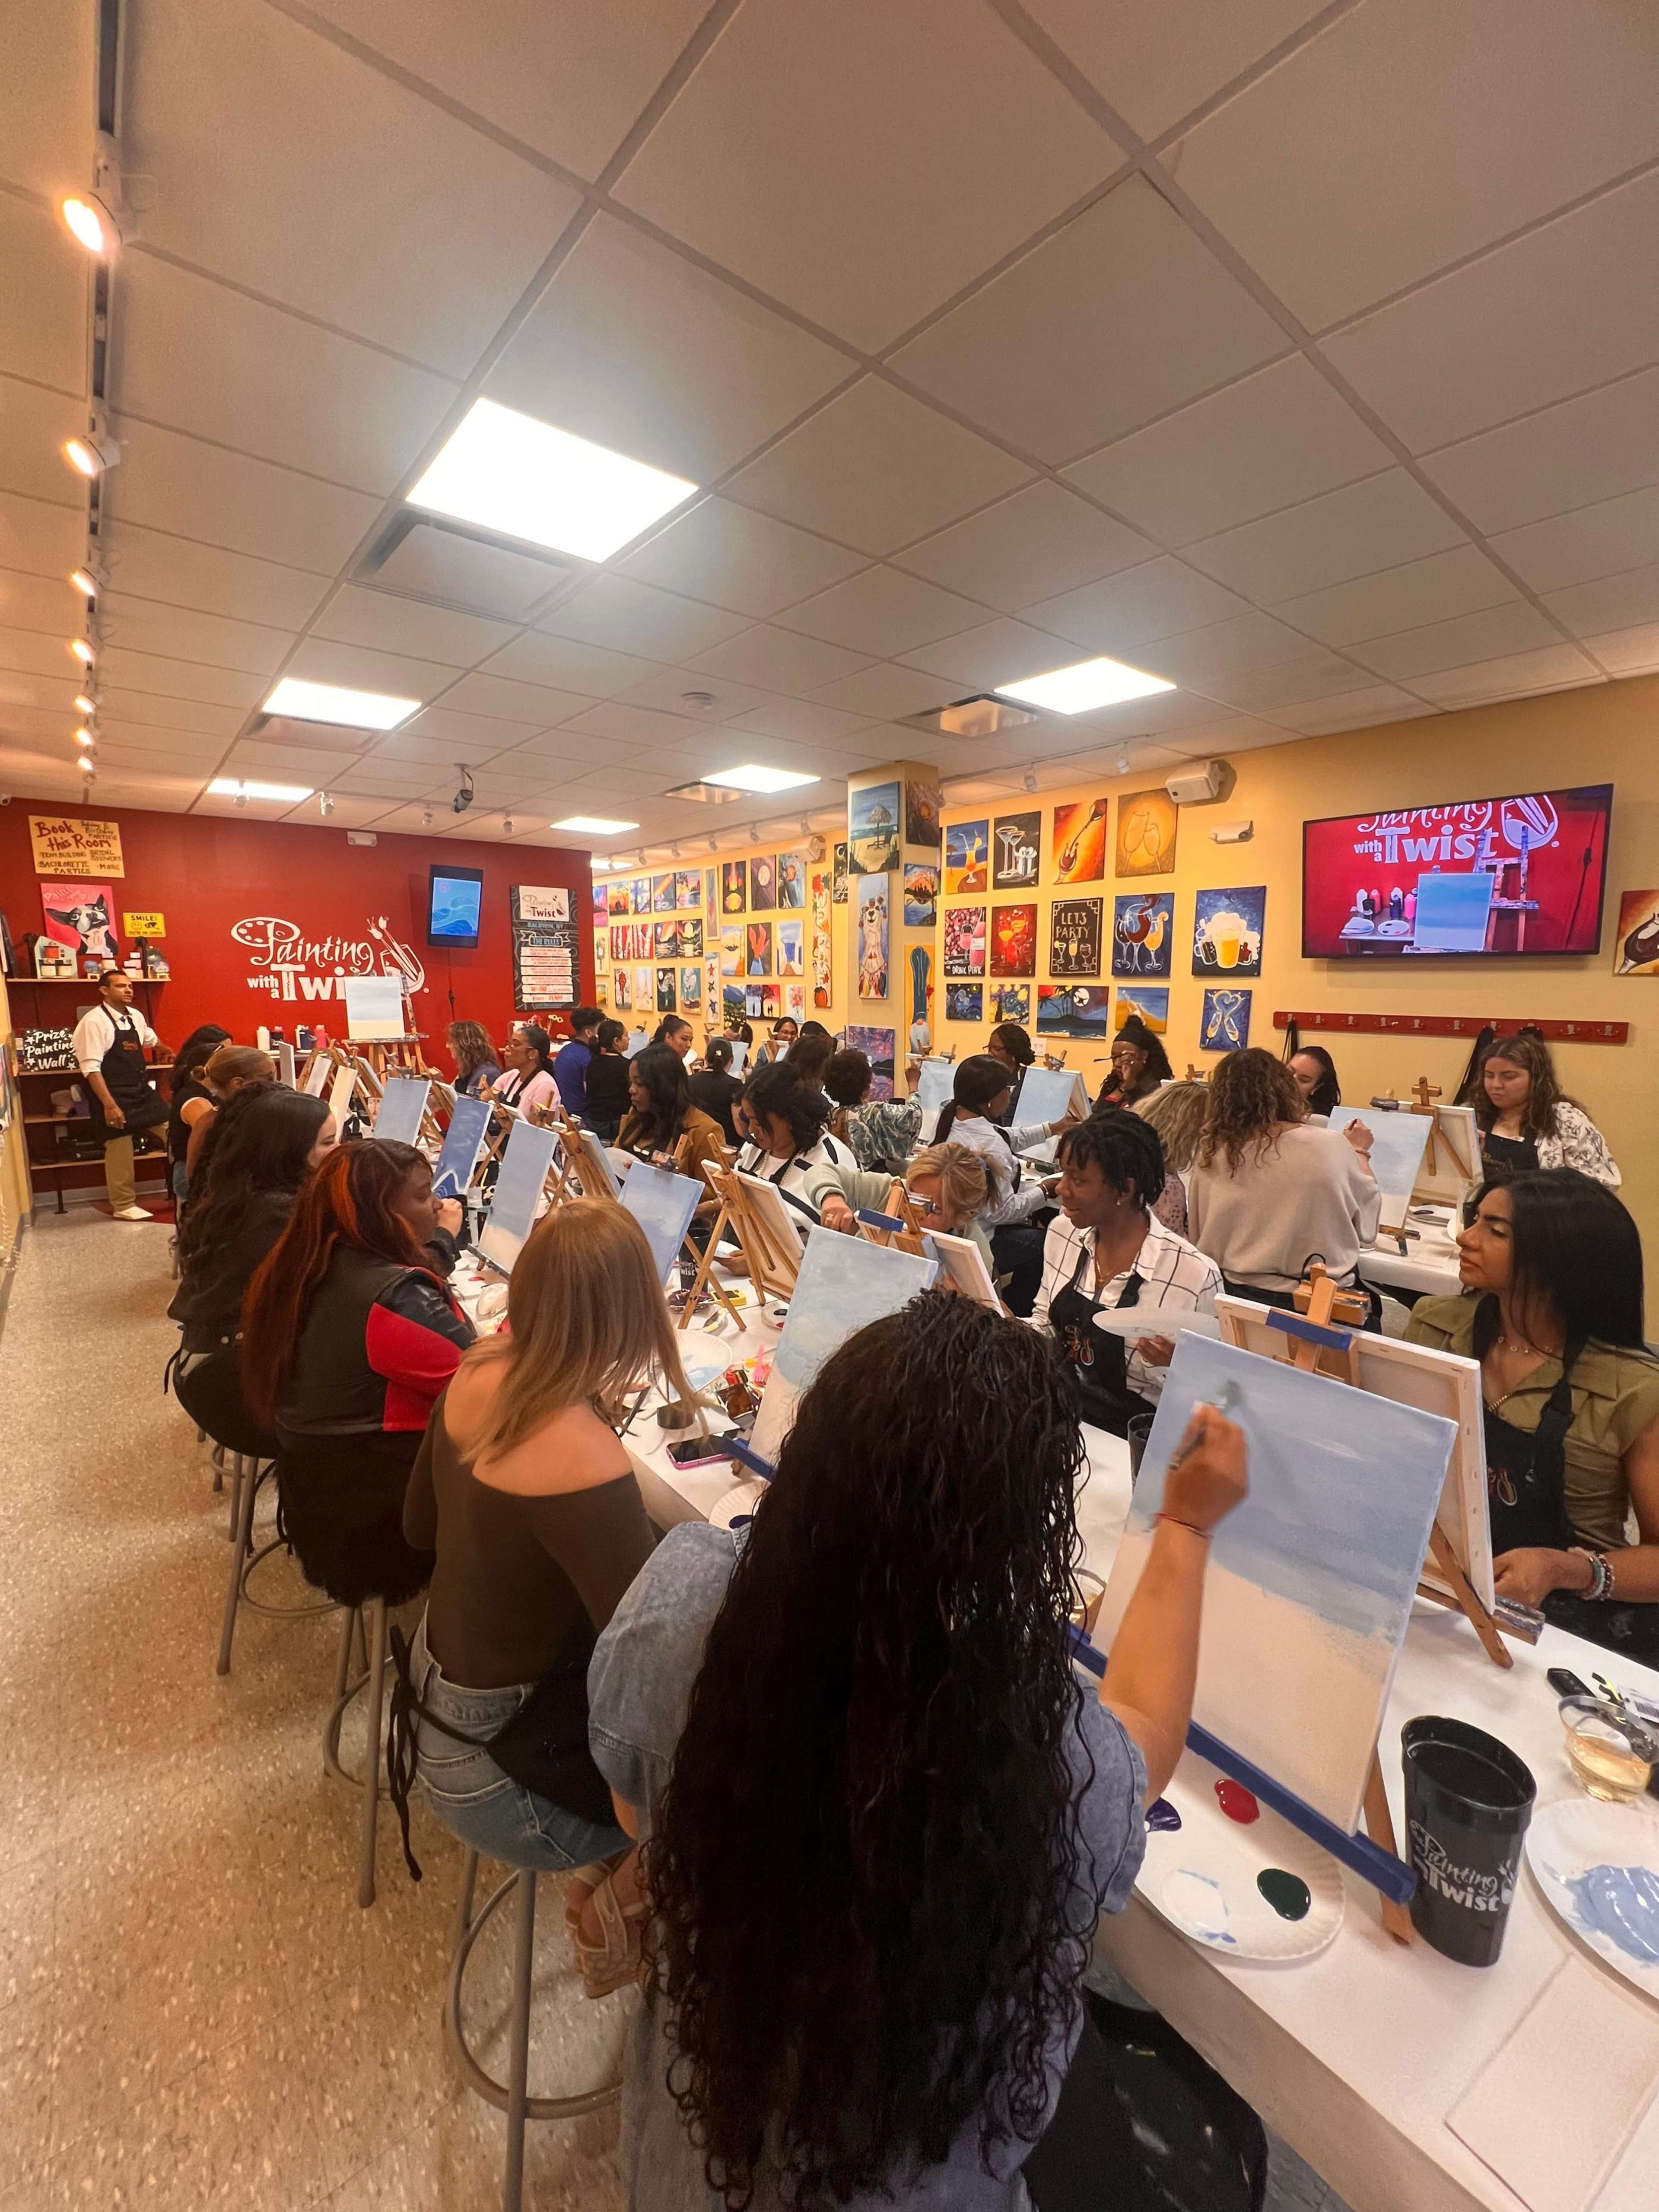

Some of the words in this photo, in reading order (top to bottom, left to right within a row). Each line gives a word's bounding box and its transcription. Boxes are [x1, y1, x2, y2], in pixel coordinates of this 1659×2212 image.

[35, 820, 74, 837] Book
[47, 836, 71, 851] this
[71, 833, 111, 849] Room
[1354, 839, 1382, 854] with
[1375, 824, 1499, 864] Twist
[1373, 852, 1382, 862] a
[530, 906, 556, 918] Twist
[1062, 912, 1087, 925] LET'S
[1056, 926, 1090, 939] PARTY
[231, 916, 374, 976] Painting
[968, 966, 982, 975] PINK
[247, 975, 279, 988] with
[270, 963, 346, 1001] Twi
[270, 988, 279, 999] a
[33, 1030, 66, 1043] Prize
[25, 1040, 75, 1058] Painting
[38, 1054, 67, 1069] Wall
[1410, 1819, 1498, 1897] Painting
[1424, 1858, 1500, 1912] Twist
